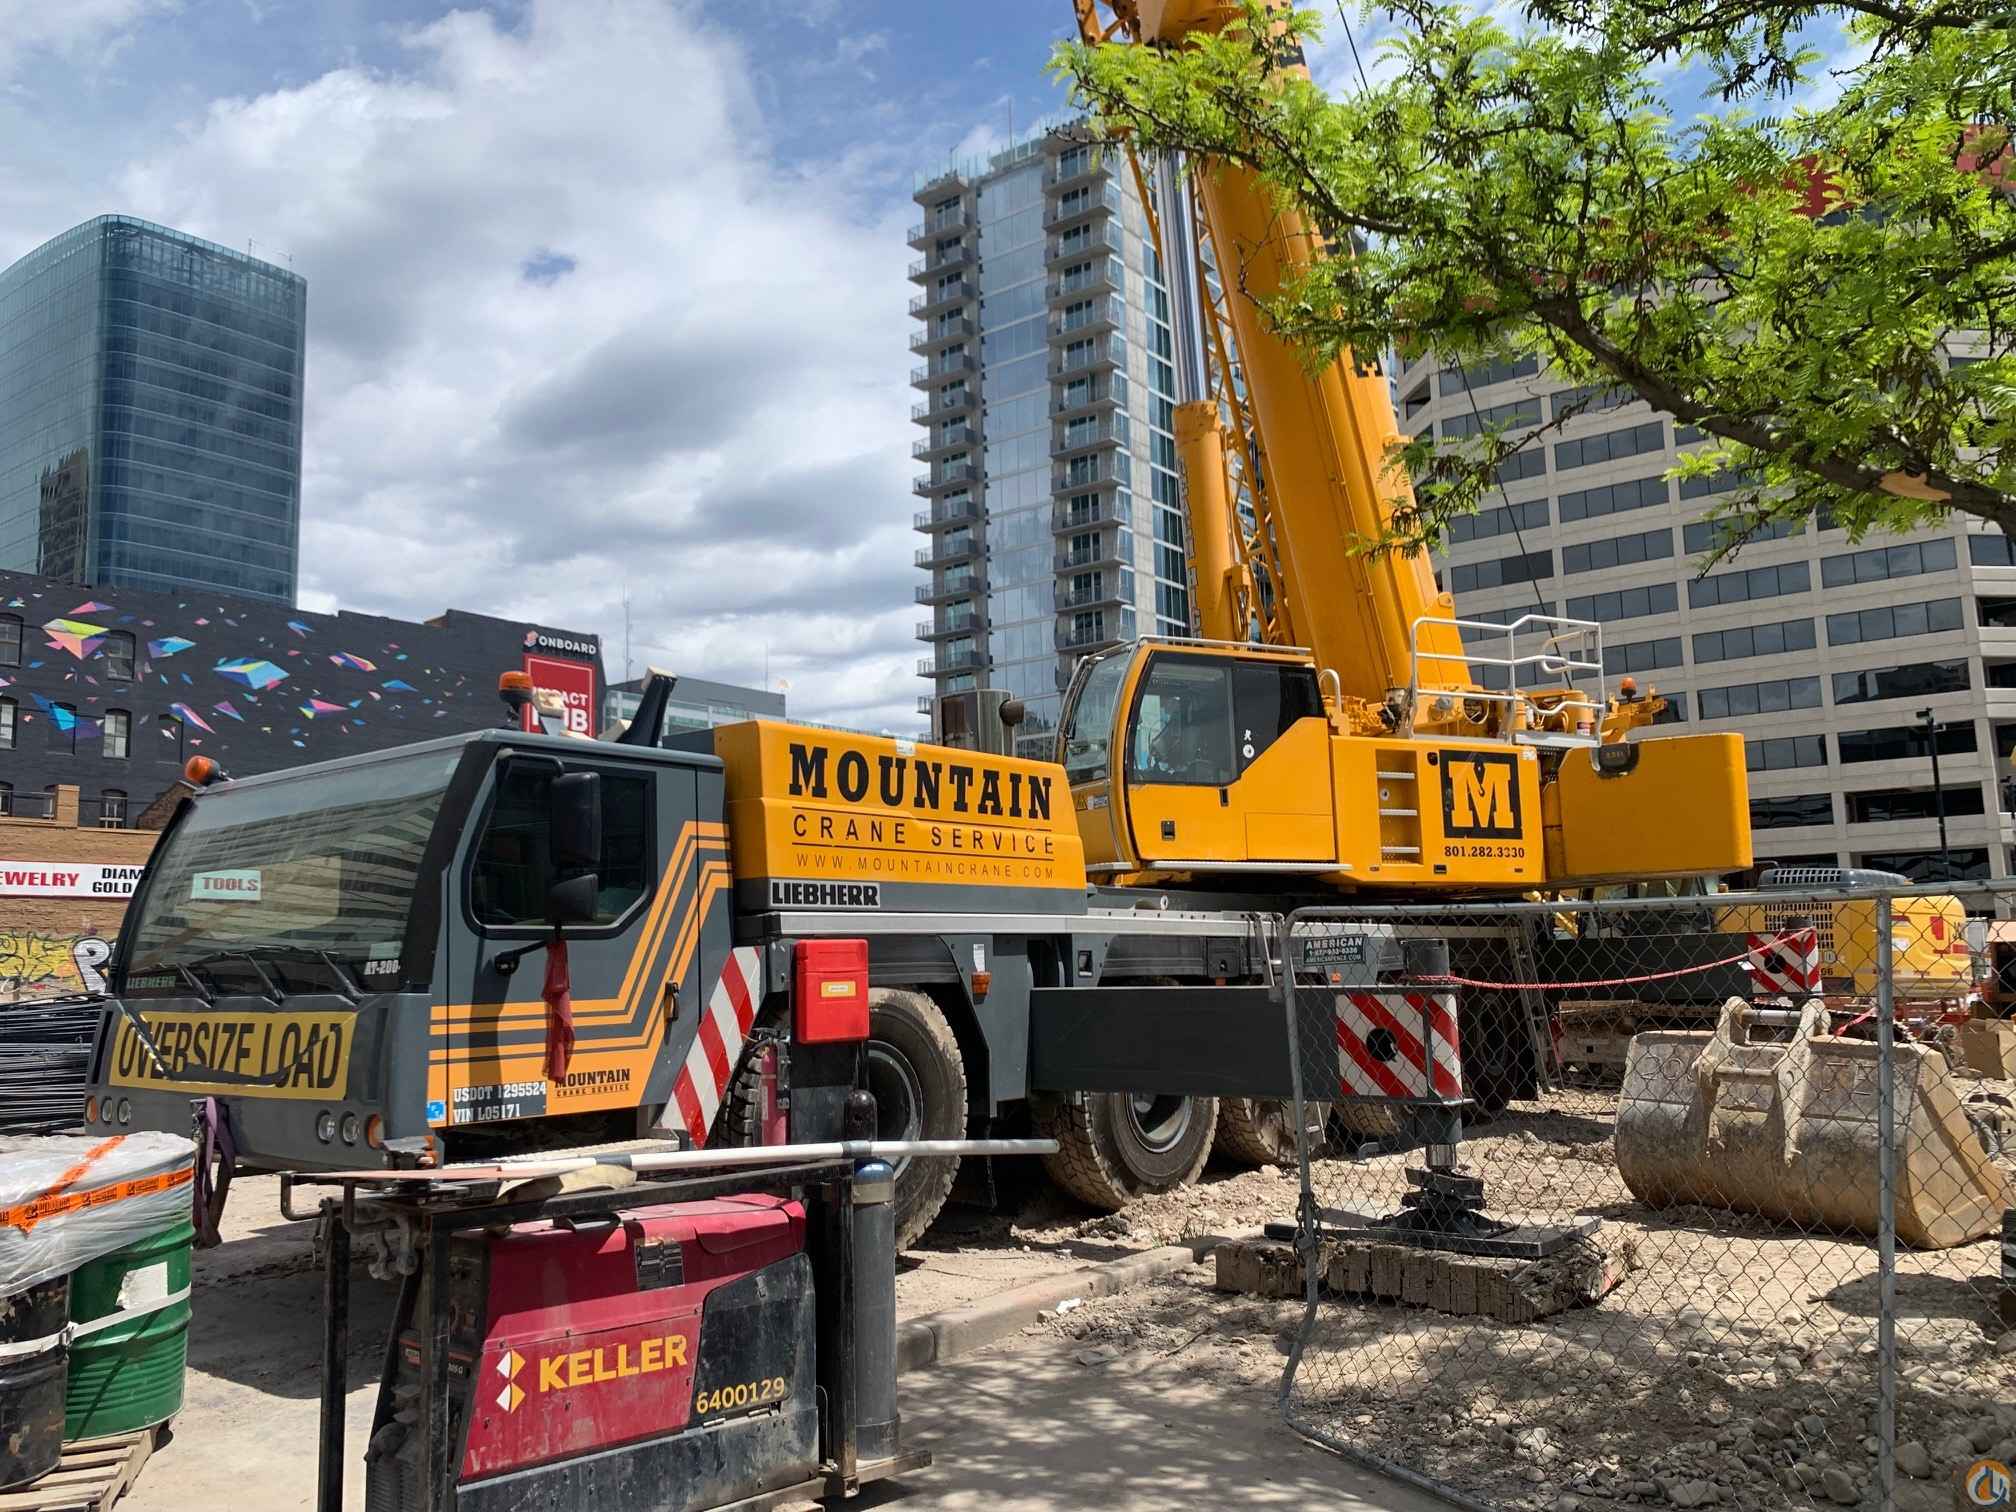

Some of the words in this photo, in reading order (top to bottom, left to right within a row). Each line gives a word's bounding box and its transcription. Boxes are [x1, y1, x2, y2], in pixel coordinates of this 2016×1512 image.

[538, 635, 597, 655] ONBOARD
[788, 743, 1052, 820] MOUNTAIN
[793, 814, 906, 844] CRANE
[931, 825, 1054, 855] SERVICE
[796, 853, 1054, 880] WWW.MOUNTAINCRANE.COM
[0, 870, 80, 887] WELRY
[92, 881, 132, 894] GOLD
[202, 876, 258, 891] TOOLS
[771, 881, 879, 906] LIEBHERR
[1306, 937, 1363, 950] AMERICAN
[119, 1021, 255, 1081] OVERSIZE
[260, 1022, 343, 1089] LOAD
[453, 1085, 494, 1102] USDOT
[498, 1081, 546, 1099] 1295524
[453, 1107, 474, 1123] VIN
[539, 1334, 689, 1393] KELLER
[696, 1376, 785, 1415] 6400129
